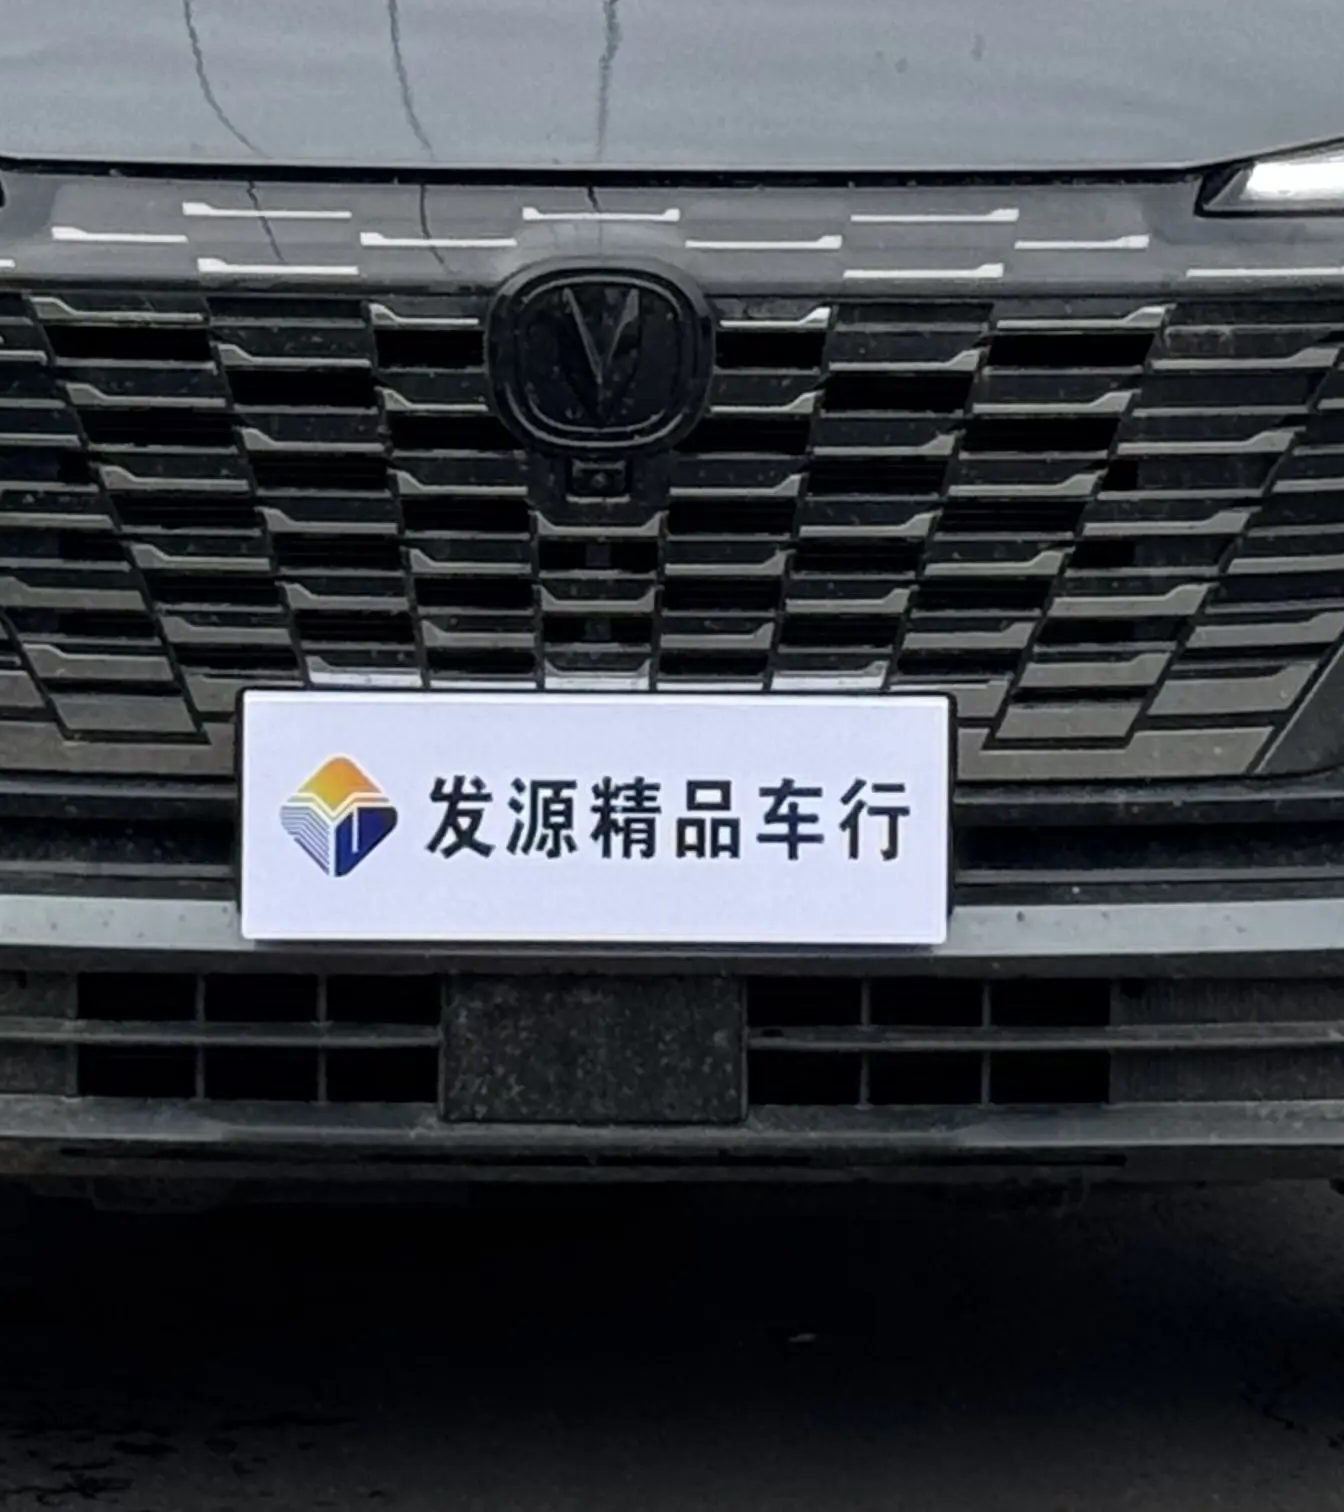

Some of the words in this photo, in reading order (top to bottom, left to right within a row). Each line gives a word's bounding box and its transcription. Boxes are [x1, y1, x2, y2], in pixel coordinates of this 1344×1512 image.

[425, 774, 911, 861] 发源精品车行
